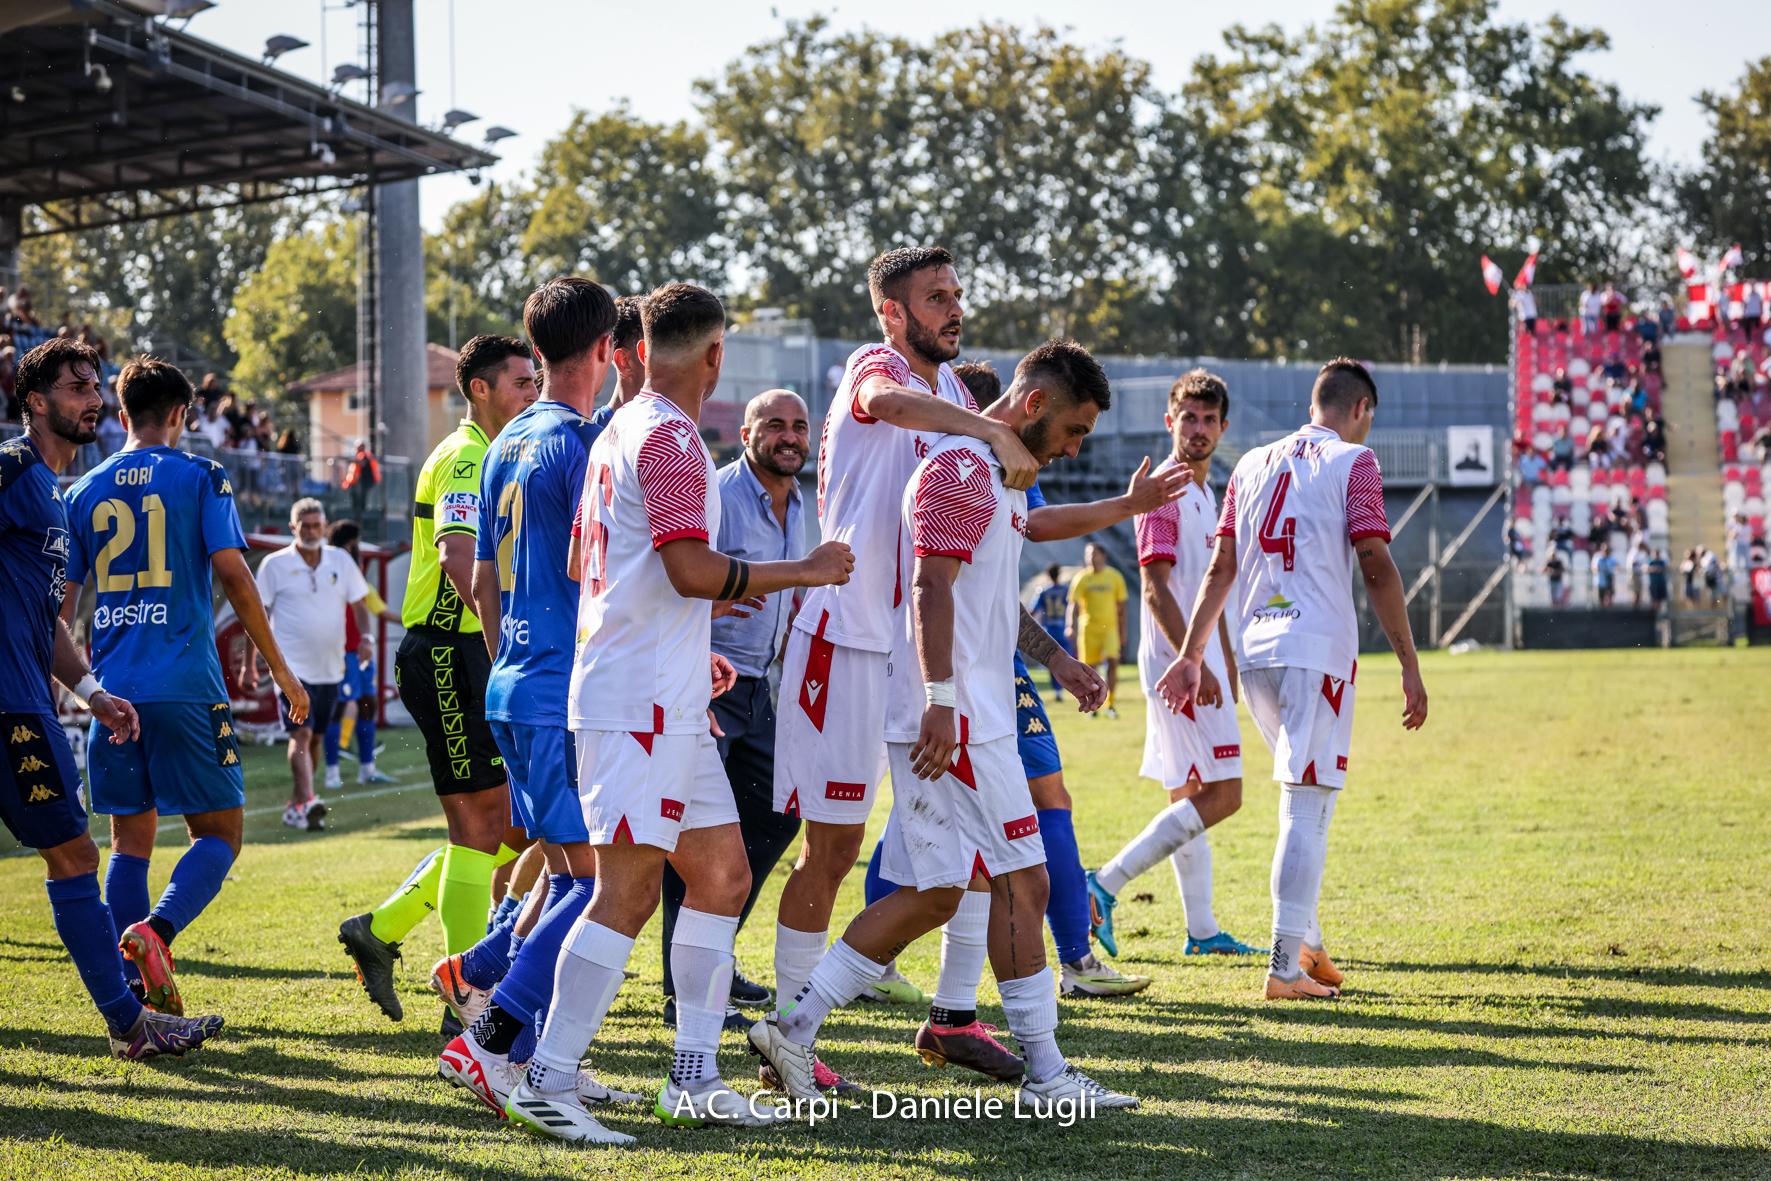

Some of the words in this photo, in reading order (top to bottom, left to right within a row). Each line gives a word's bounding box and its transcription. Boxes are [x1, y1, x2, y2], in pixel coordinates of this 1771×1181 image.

[115, 465, 153, 486] GORI
[1258, 471, 1297, 573] 4
[92, 494, 172, 593] 21
[111, 599, 168, 627] estra
[831, 790, 861, 798] JENIA
